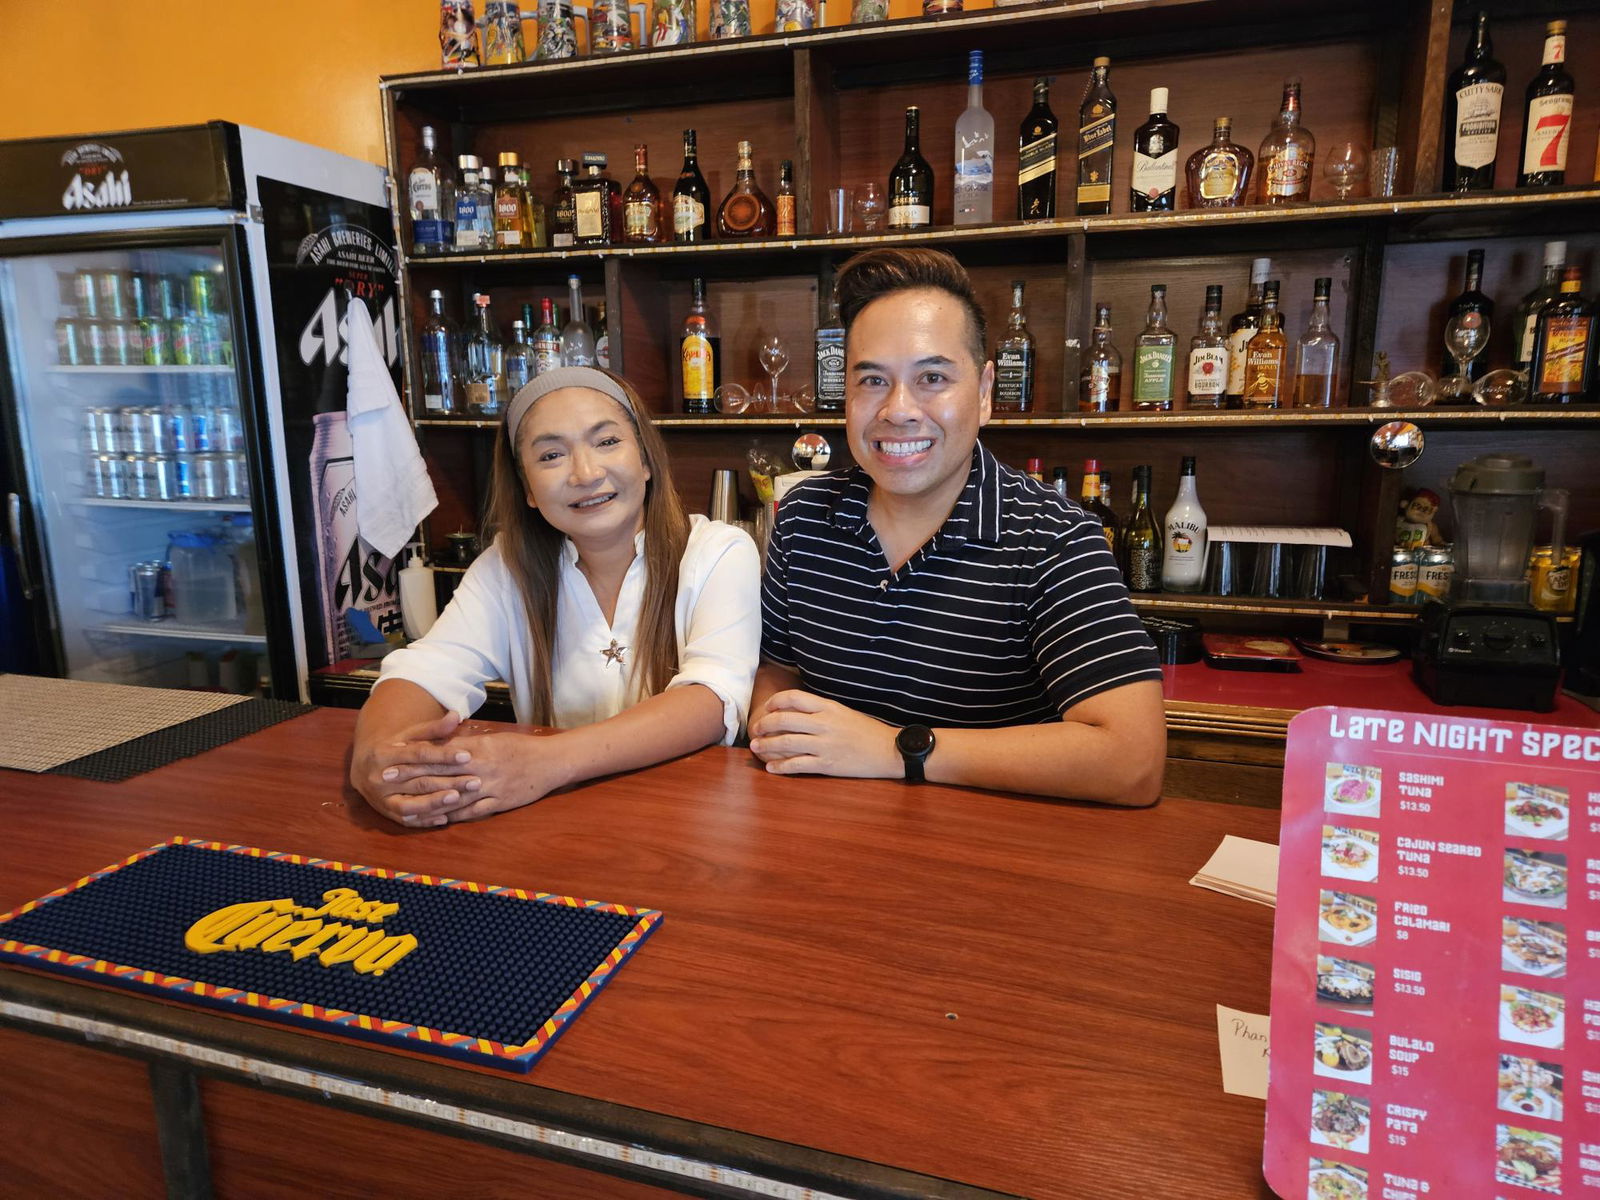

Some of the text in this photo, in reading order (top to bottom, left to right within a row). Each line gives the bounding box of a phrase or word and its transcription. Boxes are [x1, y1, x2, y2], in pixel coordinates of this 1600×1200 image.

[1534, 113, 1571, 167] 7
[62, 169, 132, 210] Asahi
[997, 359, 1027, 367] Williams
[1002, 352, 1021, 360] Evan
[1167, 521, 1202, 536] MALIBU
[1413, 721, 1513, 753] NIGHT
[1400, 800, 1431, 813] $13.50
[1398, 866, 1429, 879] $13.50
[184, 898, 418, 976] Cuervo
[1393, 968, 1422, 982] SISIG
[1389, 1048, 1420, 1064] SOUP
[1391, 1065, 1409, 1077] $15
[1386, 1104, 1427, 1121] CRISPY
[1388, 1134, 1407, 1146] $15
